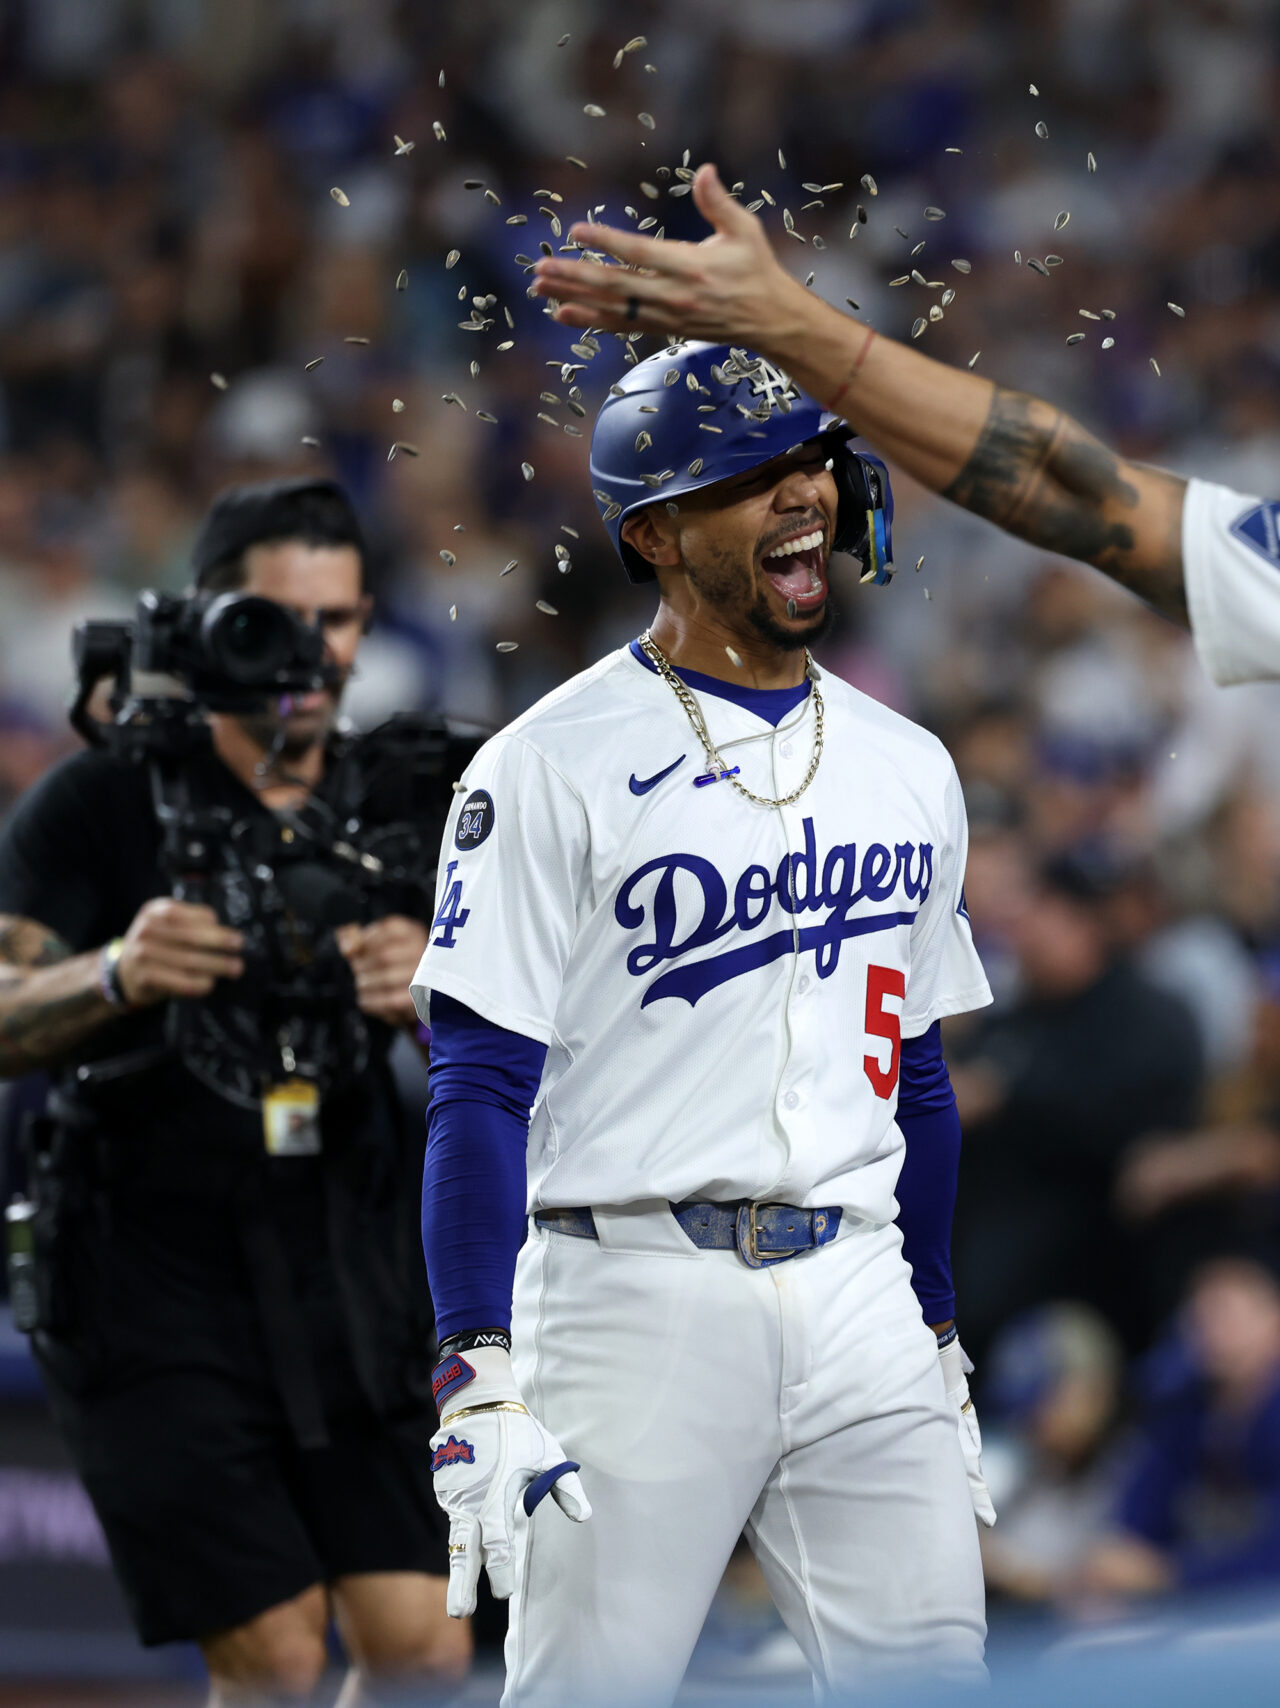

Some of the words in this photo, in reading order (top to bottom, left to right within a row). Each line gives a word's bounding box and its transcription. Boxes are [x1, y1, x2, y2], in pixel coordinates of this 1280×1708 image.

[458, 811, 484, 840] 34
[614, 817, 934, 980] Dodgers
[863, 964, 905, 1101] 5
